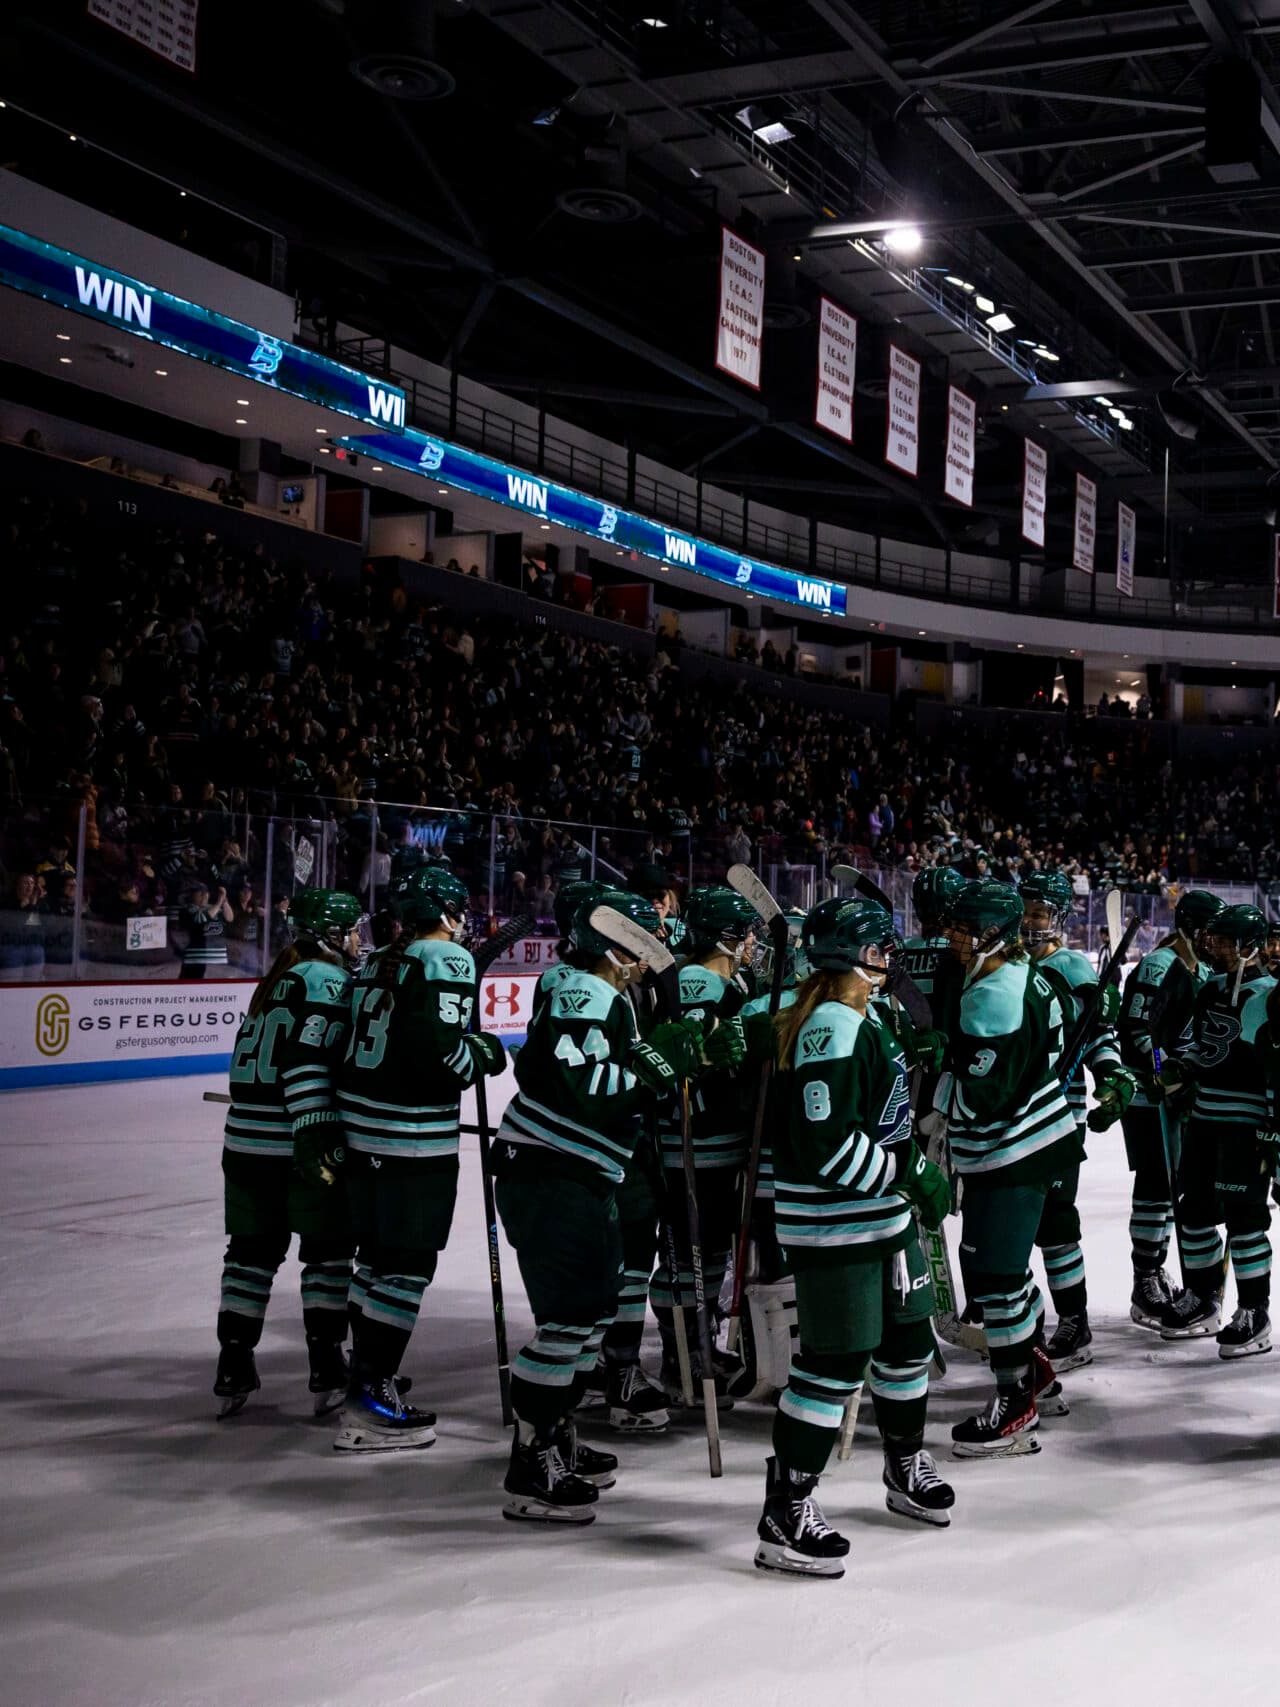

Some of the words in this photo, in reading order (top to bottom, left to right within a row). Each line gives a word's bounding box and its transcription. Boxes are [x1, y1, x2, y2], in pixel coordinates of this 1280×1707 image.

[729, 238, 757, 265] BOSTON
[724, 255, 763, 288] UNIVERSITY
[75, 266, 151, 328] WIN
[726, 299, 758, 327] EASTERN
[828, 307, 849, 328] BOSTON
[822, 323, 855, 350] UNIVERSITY
[368, 385, 405, 427] WI
[507, 474, 547, 511] WIN
[117, 500, 137, 515] 113
[665, 533, 696, 566] WIN
[797, 580, 831, 607] WIN
[535, 615, 547, 625] 114
[524, 942, 541, 963] BU
[93, 998, 152, 1006] CONSTRUCTION
[155, 996, 187, 1005] PROJECT
[189, 995, 238, 1003] MANAGEMENT
[559, 989, 593, 998] PWHL
[78, 1016, 111, 1031] GS
[299, 1014, 346, 1048] 20
[803, 1027, 834, 1039] PWHL
[115, 1033, 219, 1049] gsfergusongroup.com
[230, 1007, 296, 1084] 20
[554, 1025, 611, 1068] 44
[968, 1048, 997, 1078] 3
[803, 1079, 832, 1122] 8
[293, 1111, 340, 1136] ARRIO
[1214, 1181, 1248, 1192] AUER
[692, 1245, 704, 1303] BAUER
[1000, 1407, 1036, 1437] CCM
